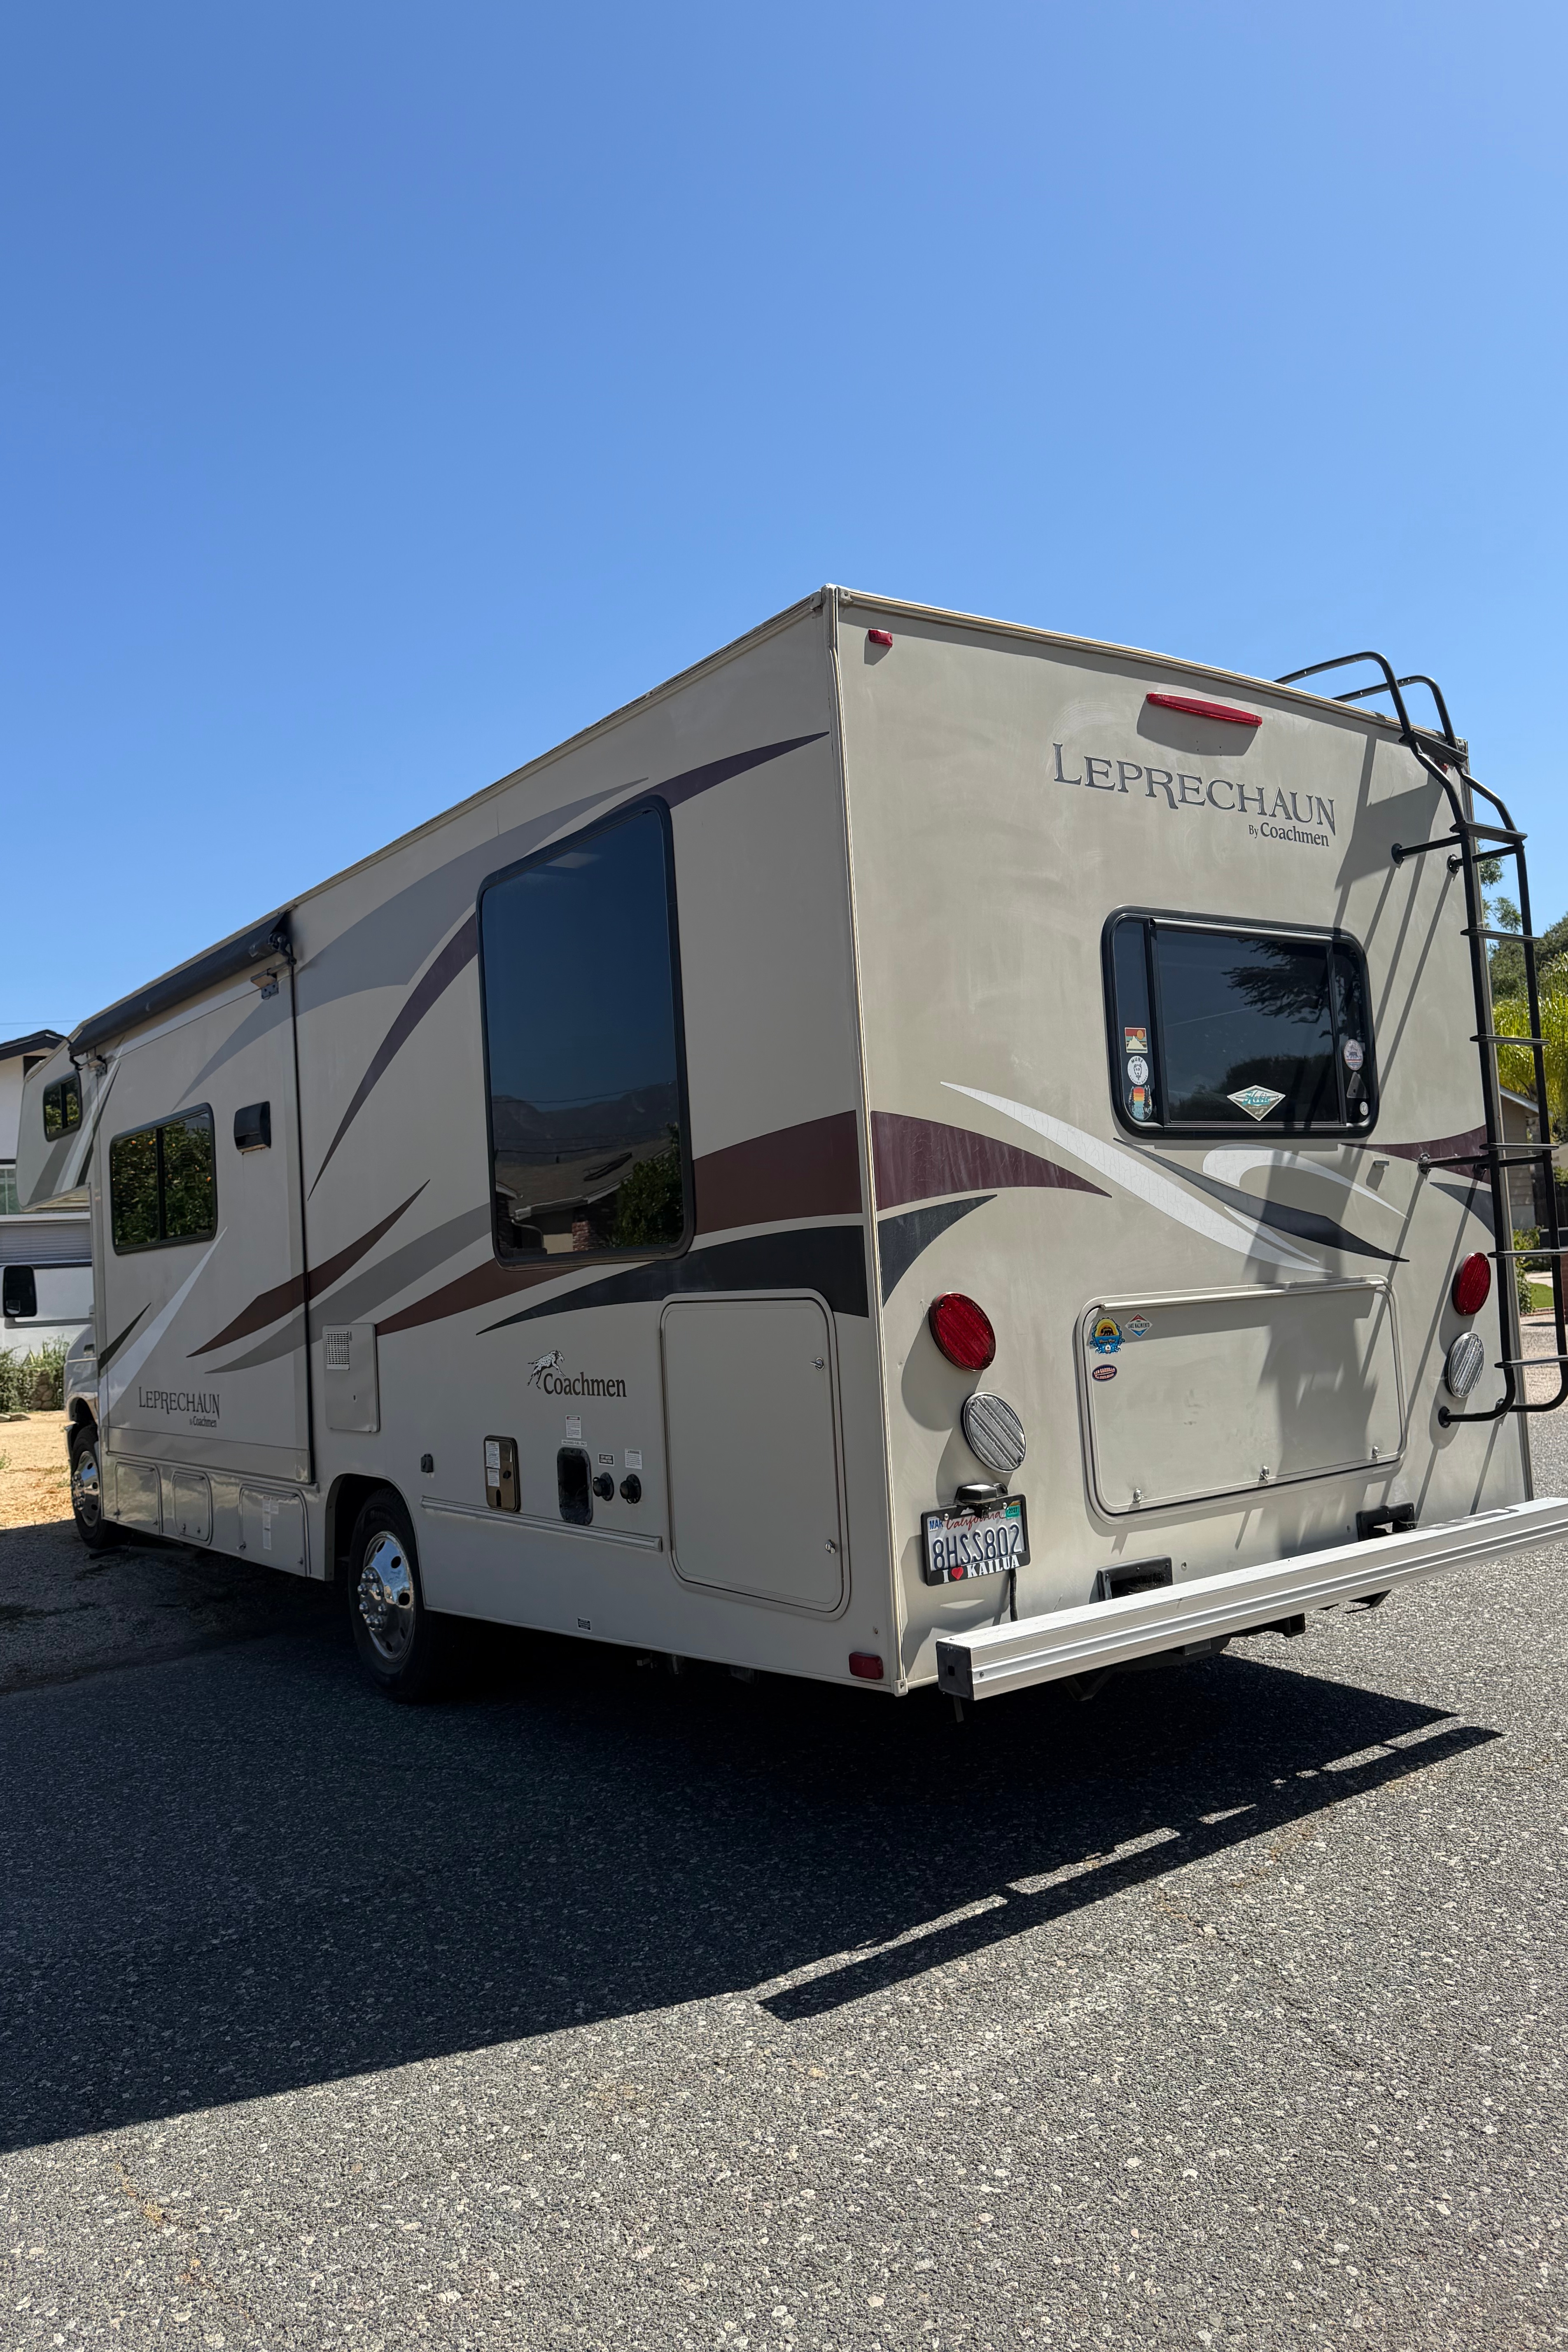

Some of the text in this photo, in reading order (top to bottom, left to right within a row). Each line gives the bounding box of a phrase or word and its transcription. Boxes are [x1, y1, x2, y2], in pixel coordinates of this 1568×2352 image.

[1052, 742, 1336, 836] LEPRECHAUN
[1248, 822, 1330, 847] By Coachmen
[544, 1372, 627, 1397] Coachmen
[139, 1386, 219, 1419] LEPRECHAUN
[929, 1520, 943, 1530] MAR
[933, 1524, 1022, 1570] 8HSS802
[942, 1555, 1020, 1583] I KAILUA
